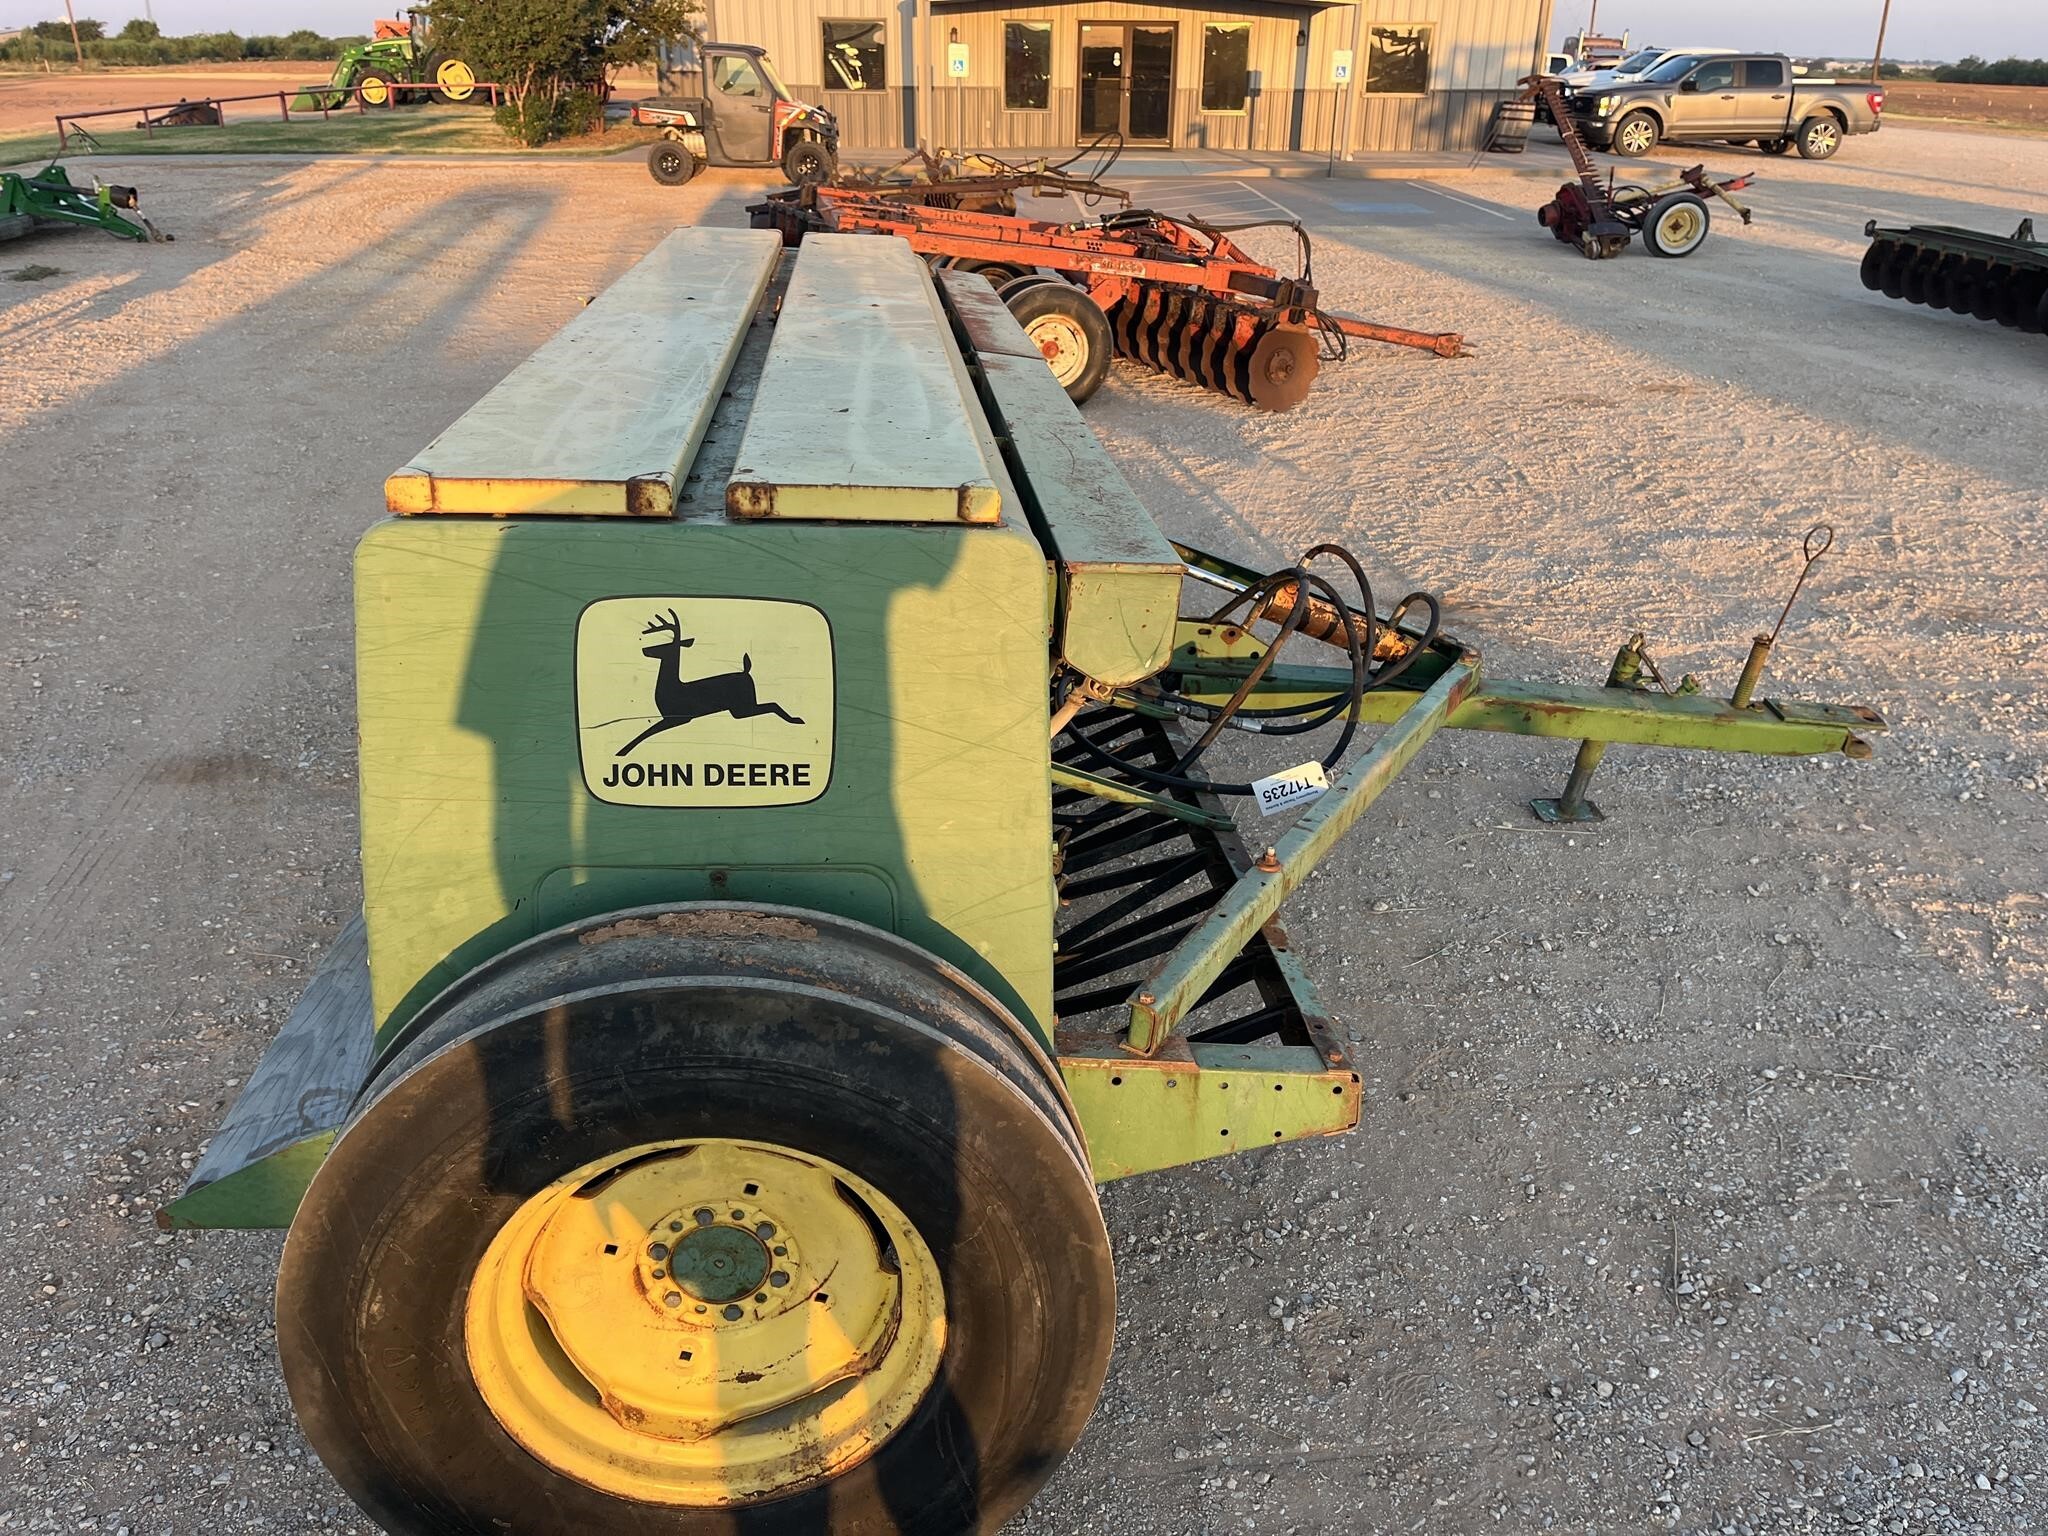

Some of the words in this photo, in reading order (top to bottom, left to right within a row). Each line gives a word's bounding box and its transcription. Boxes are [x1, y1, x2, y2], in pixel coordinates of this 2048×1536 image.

[603, 763, 692, 786] JOHN
[704, 764, 810, 786] DEERE
[1263, 777, 1314, 803] T17235
